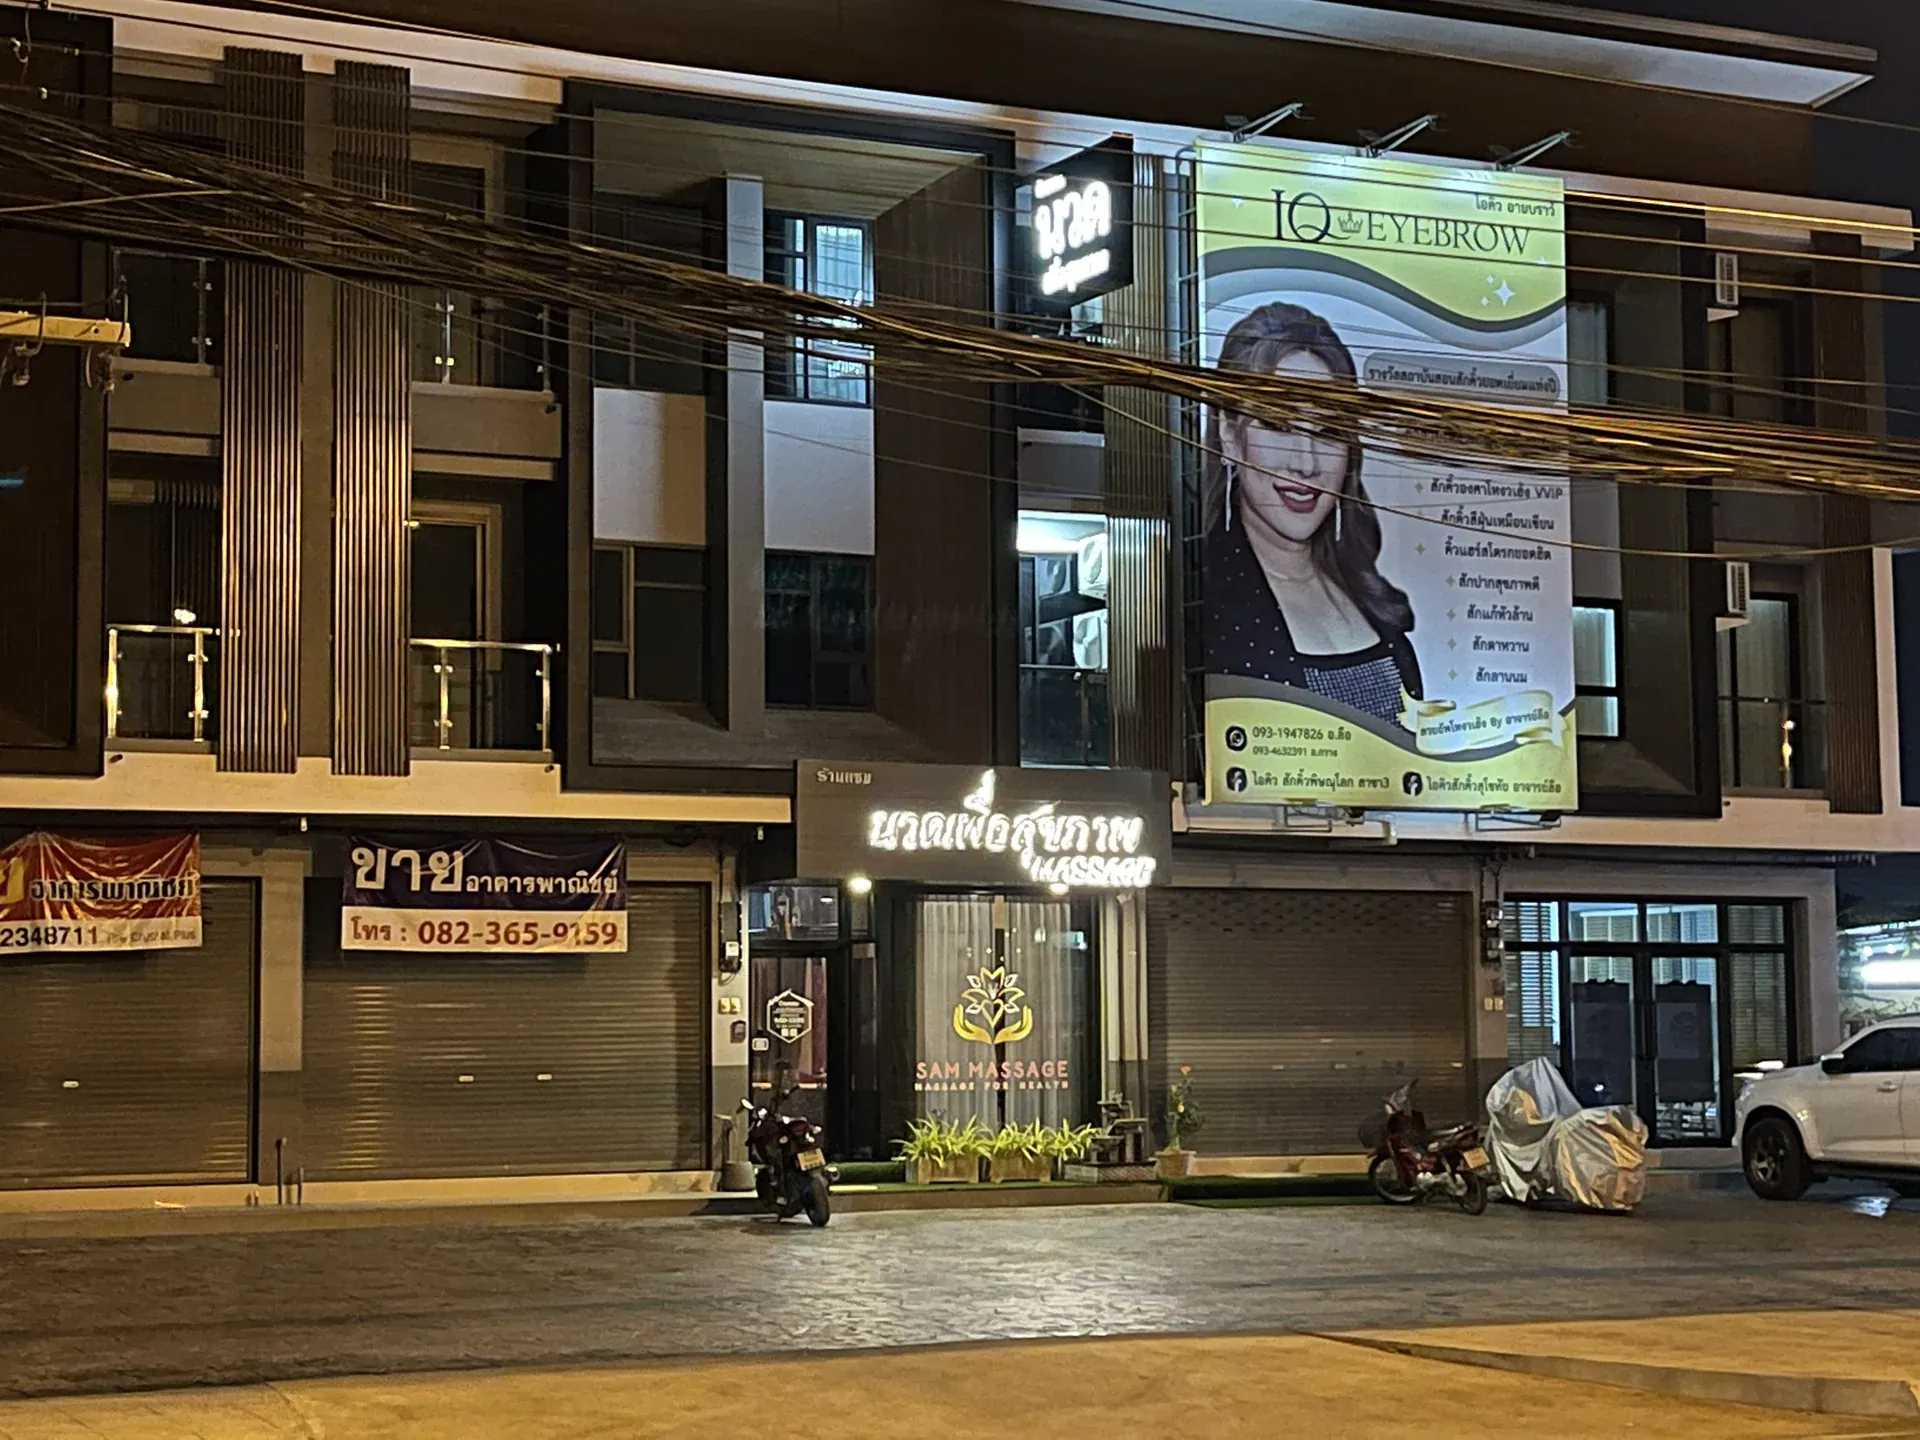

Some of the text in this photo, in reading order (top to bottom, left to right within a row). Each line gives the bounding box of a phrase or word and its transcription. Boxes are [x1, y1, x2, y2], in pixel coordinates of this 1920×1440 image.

[1271, 188, 1530, 255] IQ EYEBROW
[1252, 726, 1324, 740] 093-1947826
[816, 767, 872, 785] ร้านแซม
[351, 846, 618, 894] ขาย อาคารพาณิชย์
[351, 915, 391, 941] โทร
[916, 1060, 1069, 1080] SAM MASSAGE
